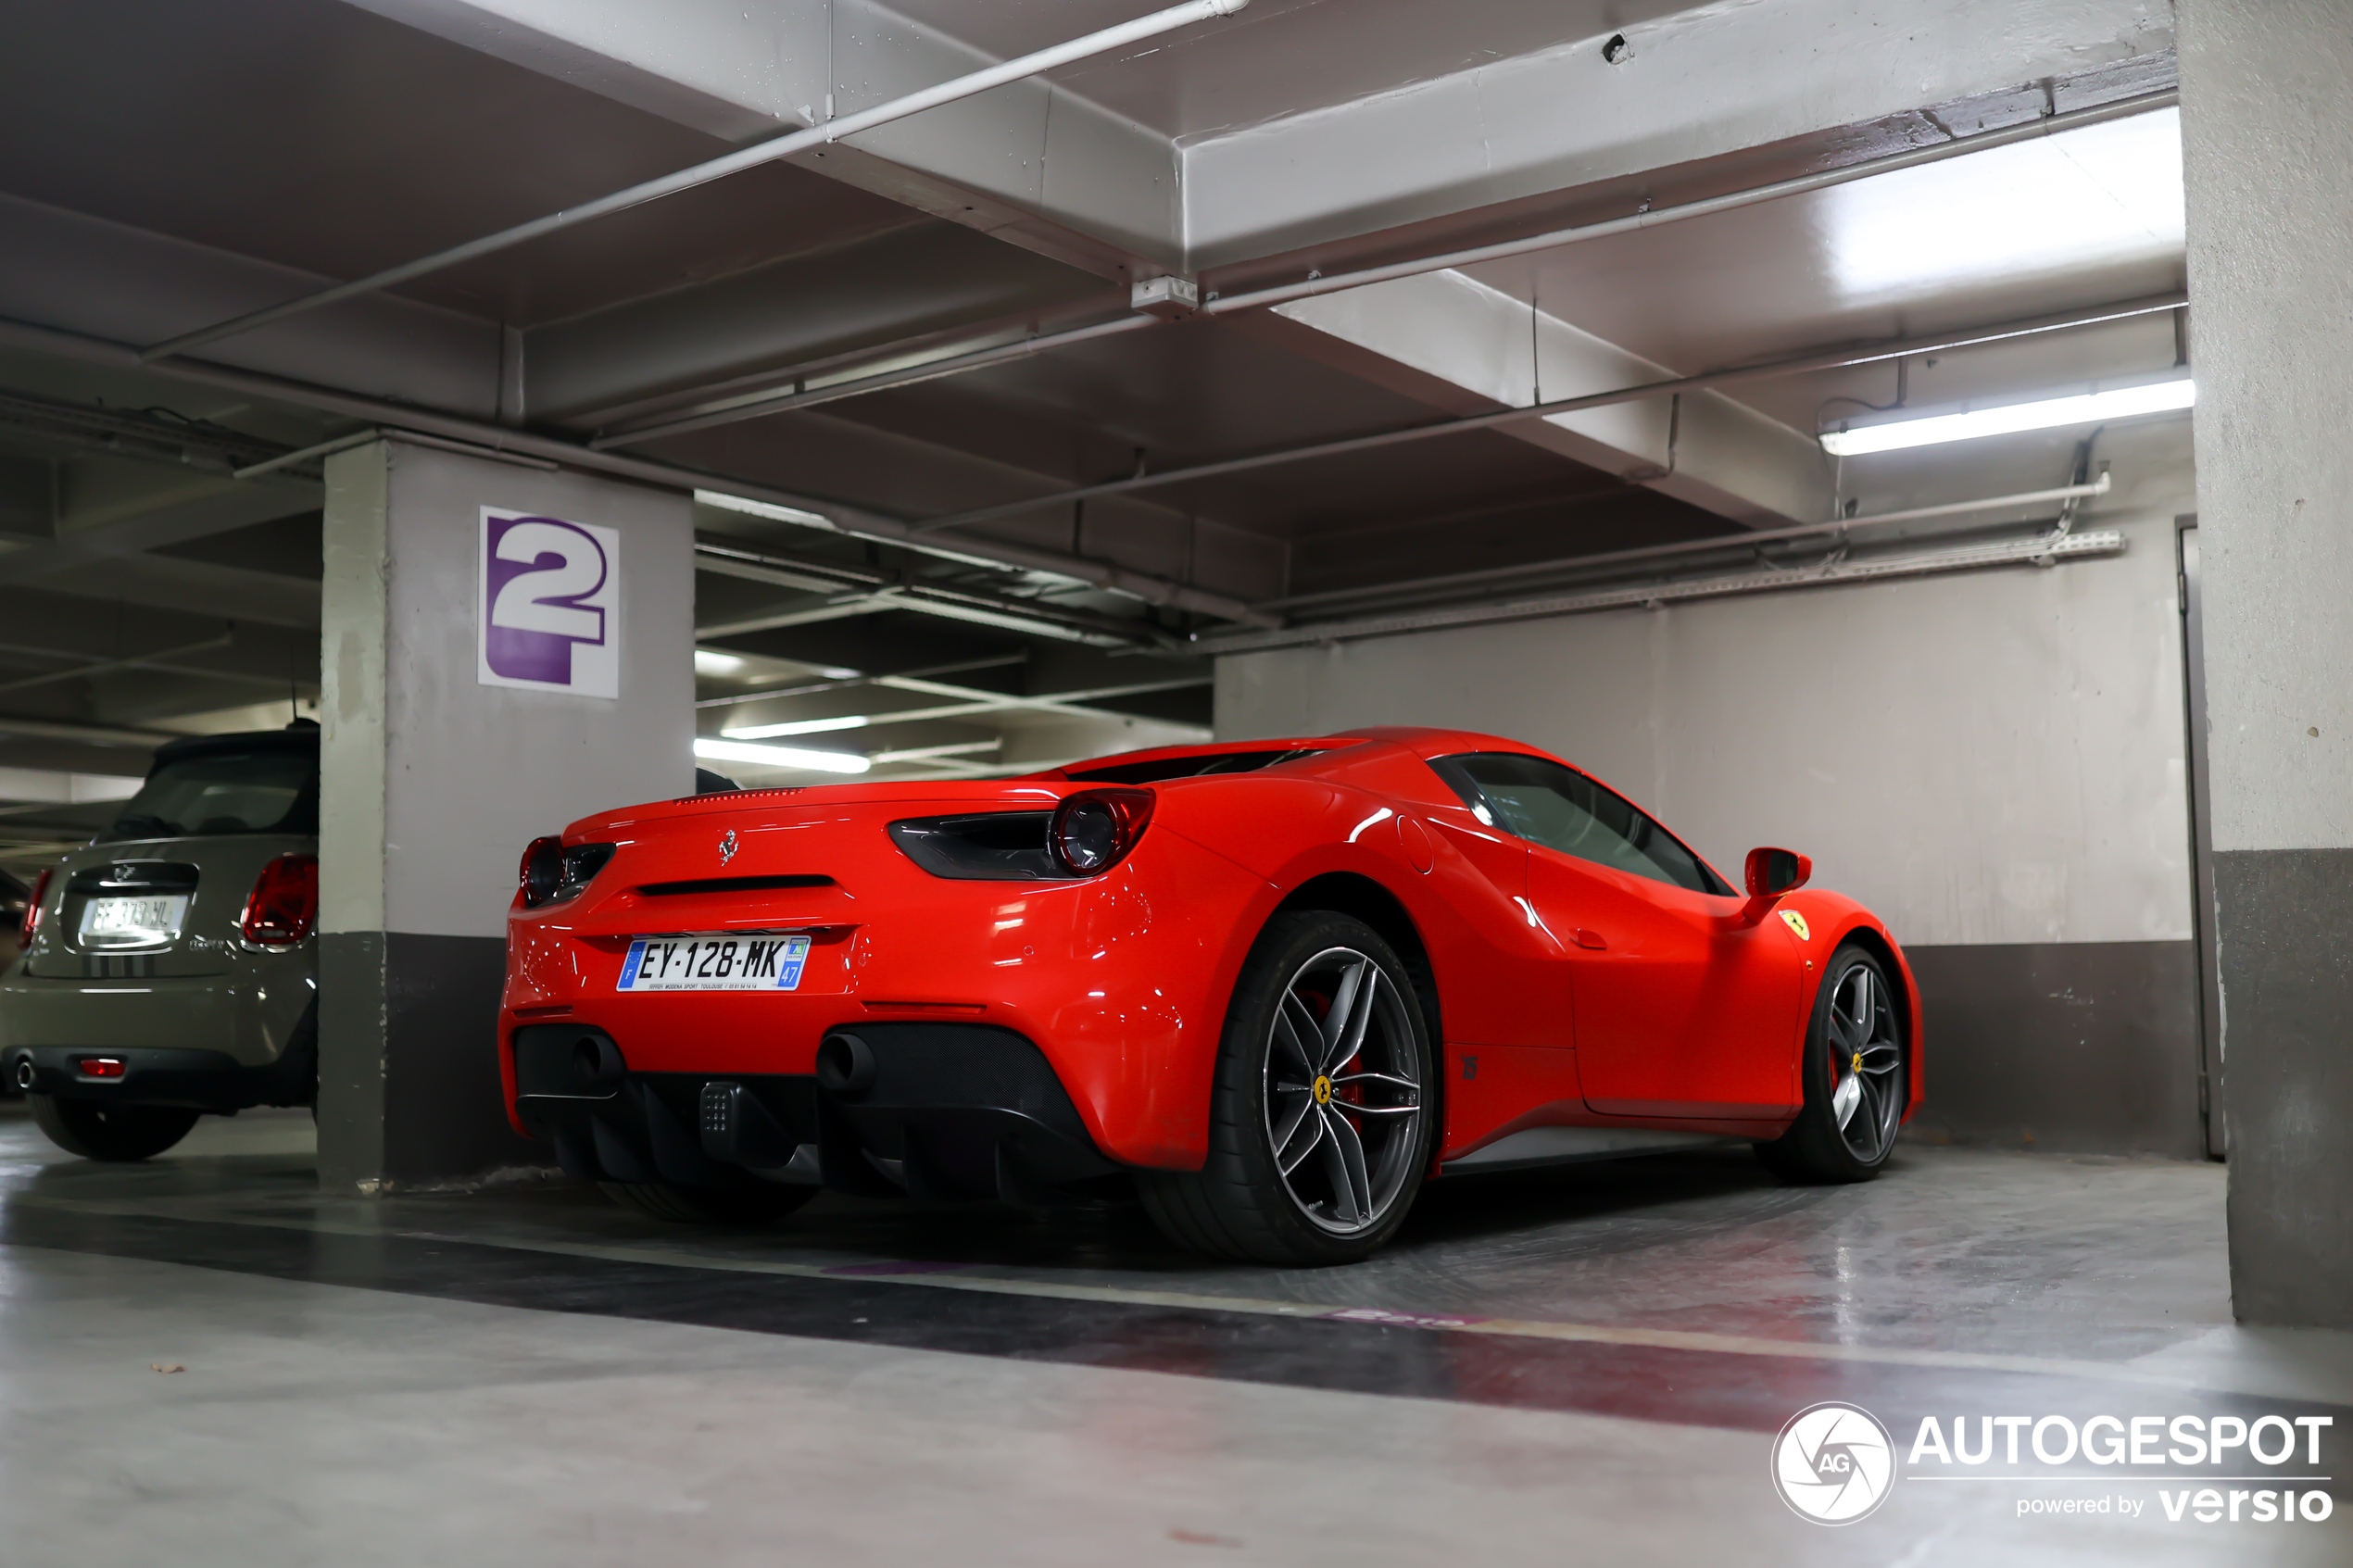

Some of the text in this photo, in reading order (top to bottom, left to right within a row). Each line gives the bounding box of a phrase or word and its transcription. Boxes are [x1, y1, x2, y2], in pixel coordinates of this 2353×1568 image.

[491, 519, 605, 644] 2
[625, 969, 633, 980] F
[781, 966, 798, 983] 47
